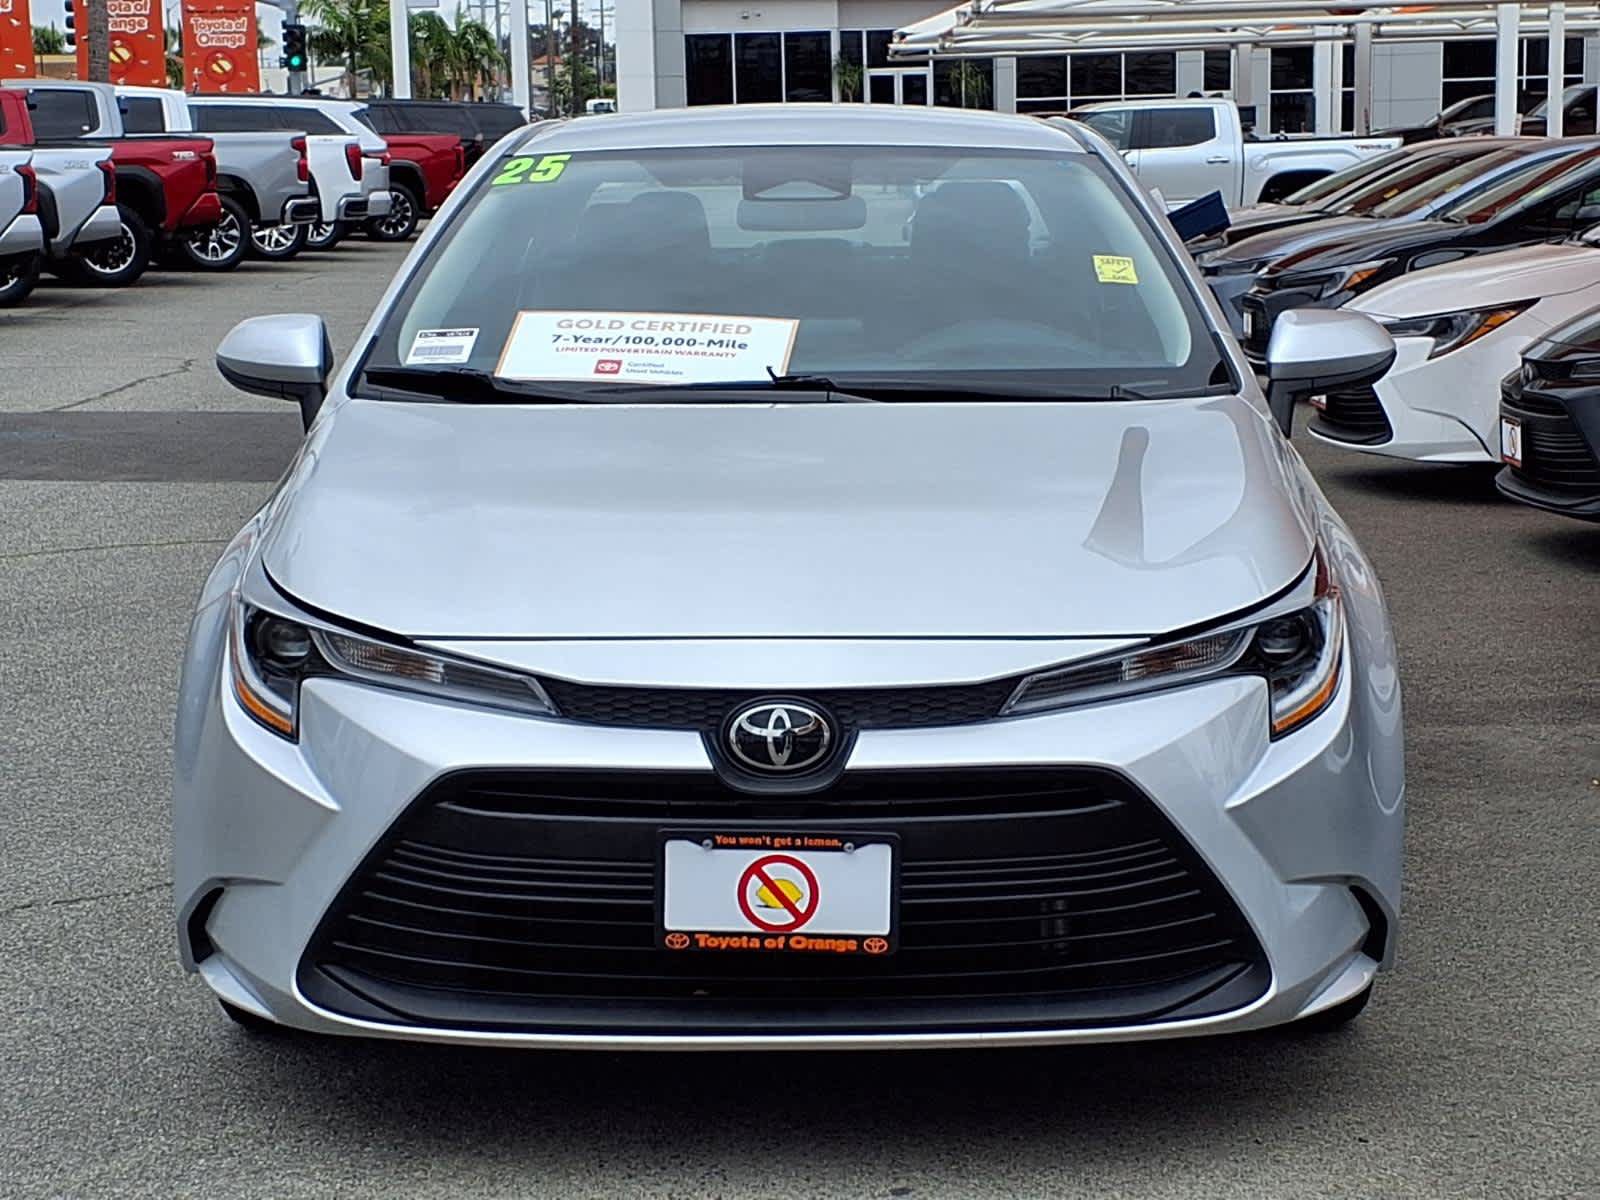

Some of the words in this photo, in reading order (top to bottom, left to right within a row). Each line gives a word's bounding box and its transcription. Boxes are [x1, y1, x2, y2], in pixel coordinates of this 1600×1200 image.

[108, 17, 148, 33] ange
[191, 17, 234, 33] Toyota
[234, 17, 247, 31] of
[197, 32, 245, 48] Orange
[491, 154, 572, 185] 25
[556, 319, 625, 331] GOLD
[630, 320, 752, 335] CERTIFIED
[552, 334, 749, 350] 7-Year/100,000-Mile
[599, 347, 673, 356] POWERTRAIN
[674, 350, 738, 359] WARRANTY
[715, 835, 737, 845] You
[739, 835, 771, 846] won't
[795, 838, 802, 846] a
[804, 836, 843, 847] lemon.
[695, 933, 760, 949] Toyota
[764, 935, 785, 949] of
[789, 935, 858, 952] Orange
